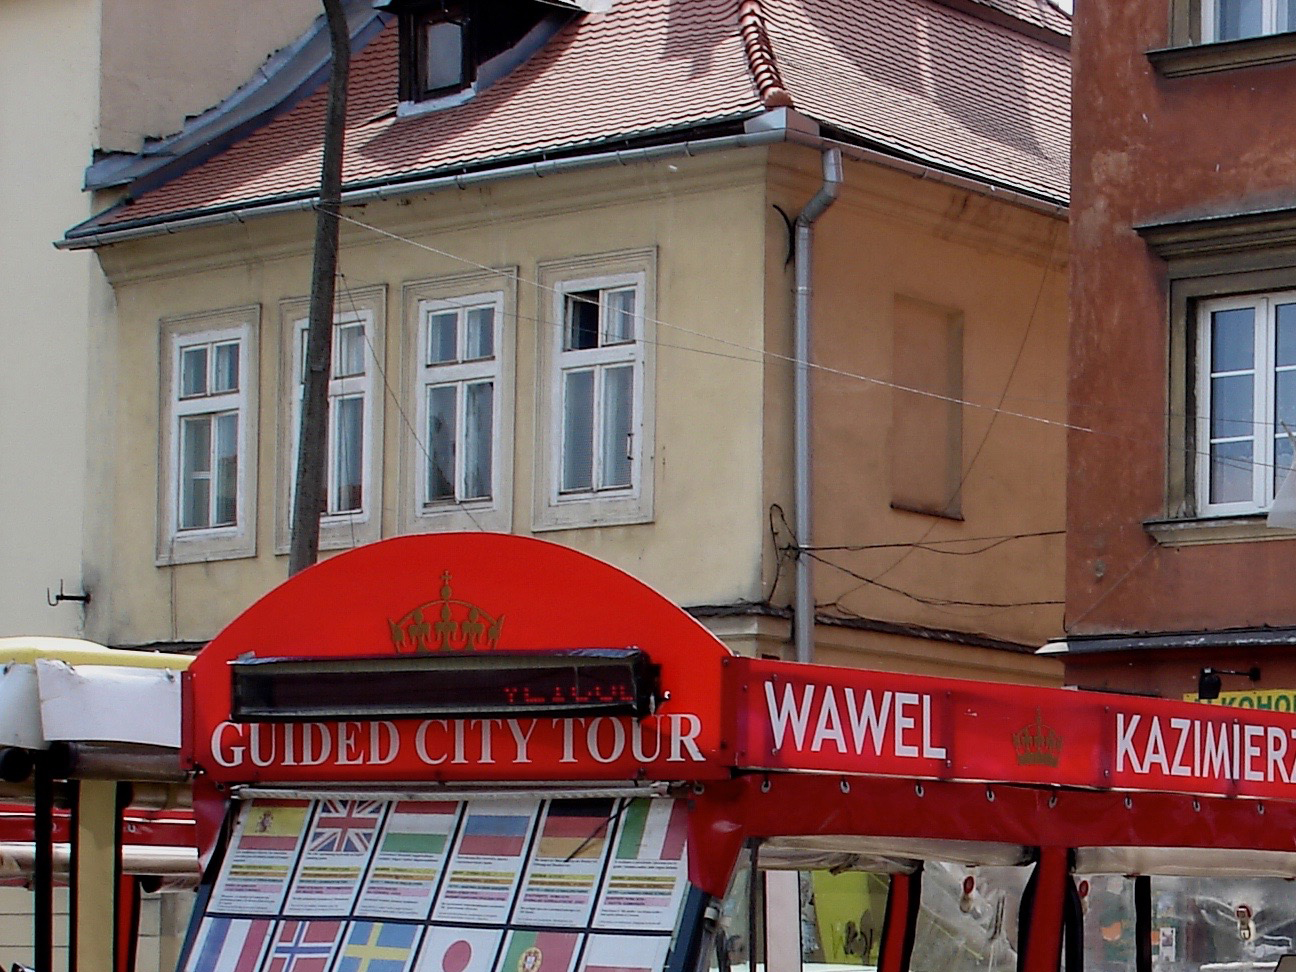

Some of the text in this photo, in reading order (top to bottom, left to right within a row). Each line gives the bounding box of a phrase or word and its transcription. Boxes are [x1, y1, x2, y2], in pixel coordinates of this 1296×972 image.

[209, 712, 708, 769] GUIDED CITY TOUR
[763, 680, 947, 760] WAWEL
